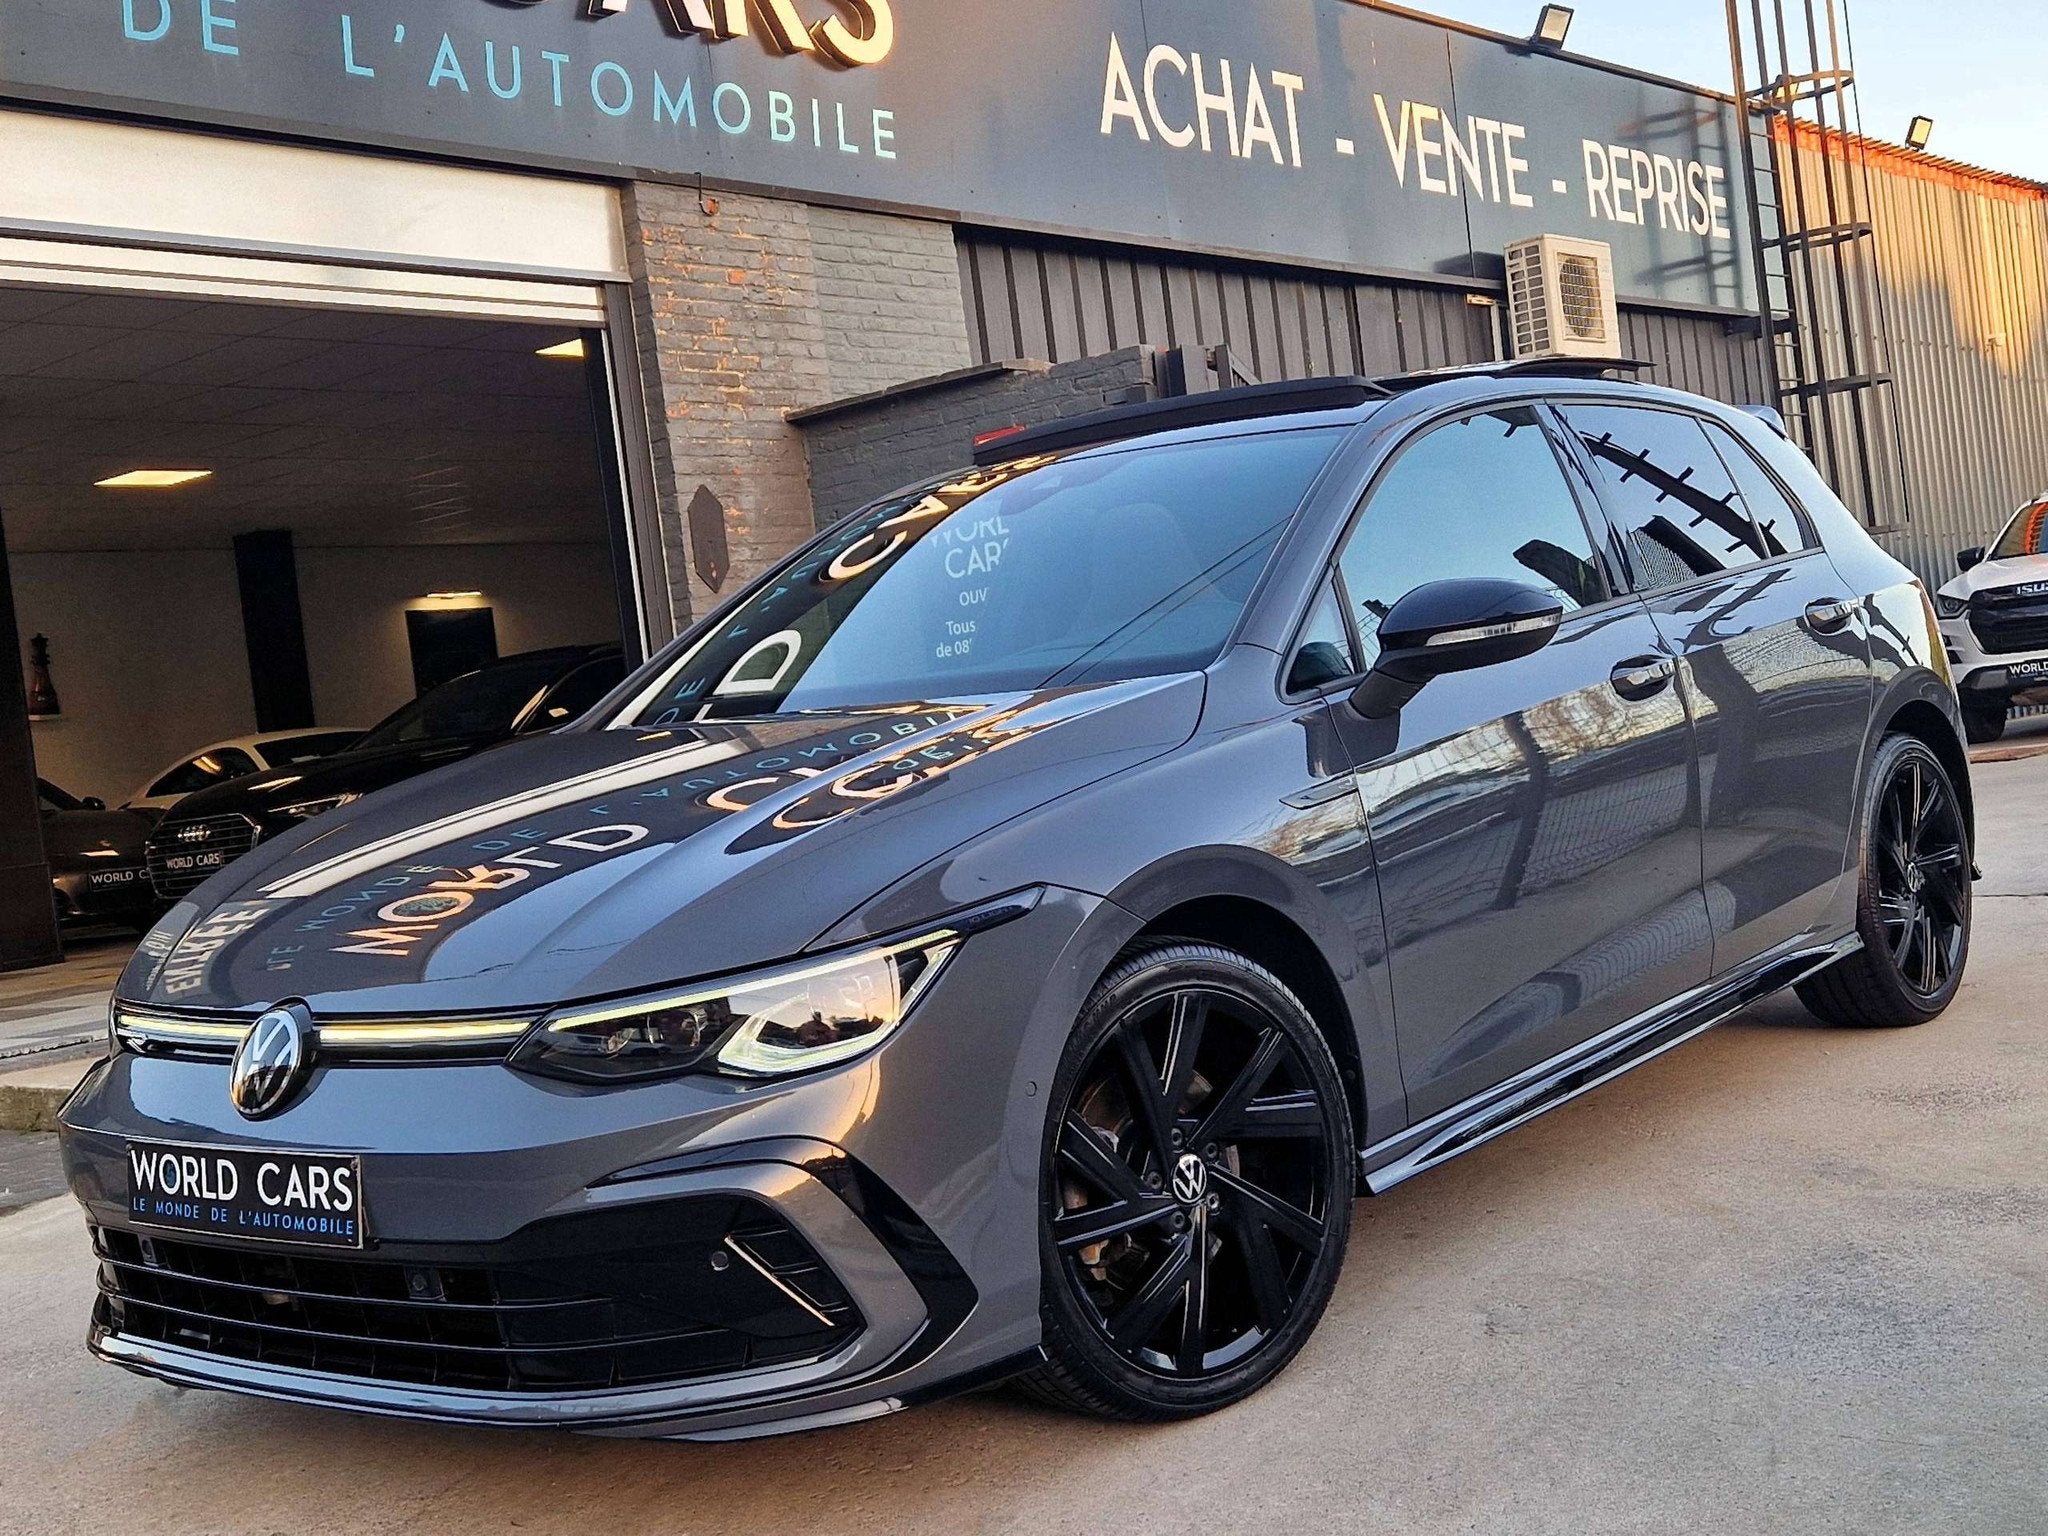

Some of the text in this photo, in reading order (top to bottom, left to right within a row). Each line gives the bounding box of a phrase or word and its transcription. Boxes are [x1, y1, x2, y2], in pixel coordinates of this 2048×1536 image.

[123, 0, 240, 56] DE
[341, 14, 898, 160] L'AUTOMOBILE
[1100, 32, 1304, 168] ACHAT
[1374, 93, 1534, 208] VENTE
[1582, 138, 1731, 239] REPRISE
[945, 620, 977, 636] Tous
[936, 642, 952, 658] de
[165, 853, 220, 869] WORLD CARS
[91, 870, 134, 884] WORLD
[130, 1149, 354, 1213] WORLD CARS
[133, 1197, 354, 1236] LE MONDE DE L'AUTOMOBILE
